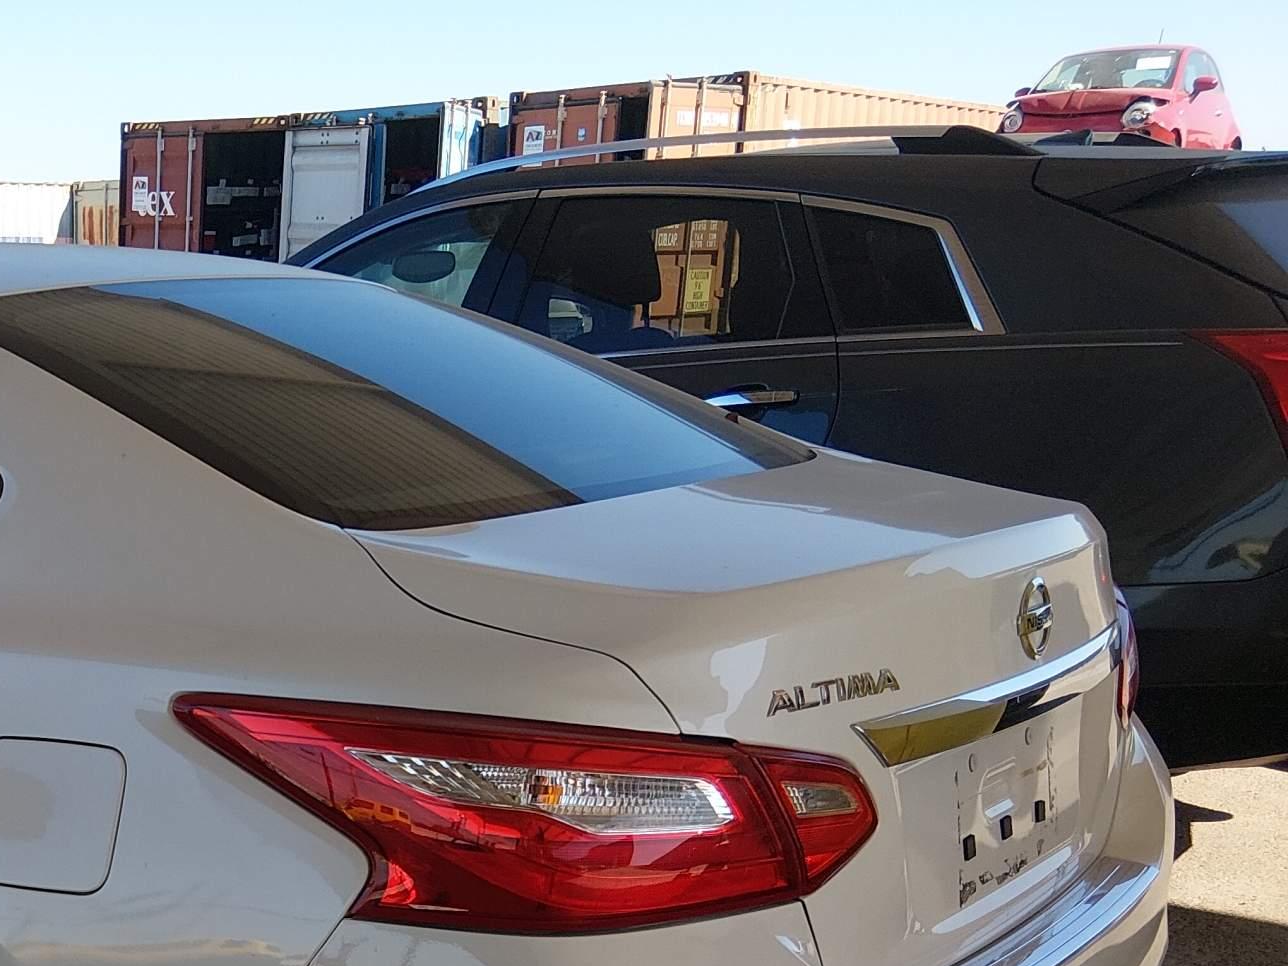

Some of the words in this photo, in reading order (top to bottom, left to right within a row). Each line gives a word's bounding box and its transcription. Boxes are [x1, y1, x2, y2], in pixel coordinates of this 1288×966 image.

[526, 130, 542, 142] AZ
[139, 191, 175, 216] ex
[766, 667, 901, 717] ALTIMA
